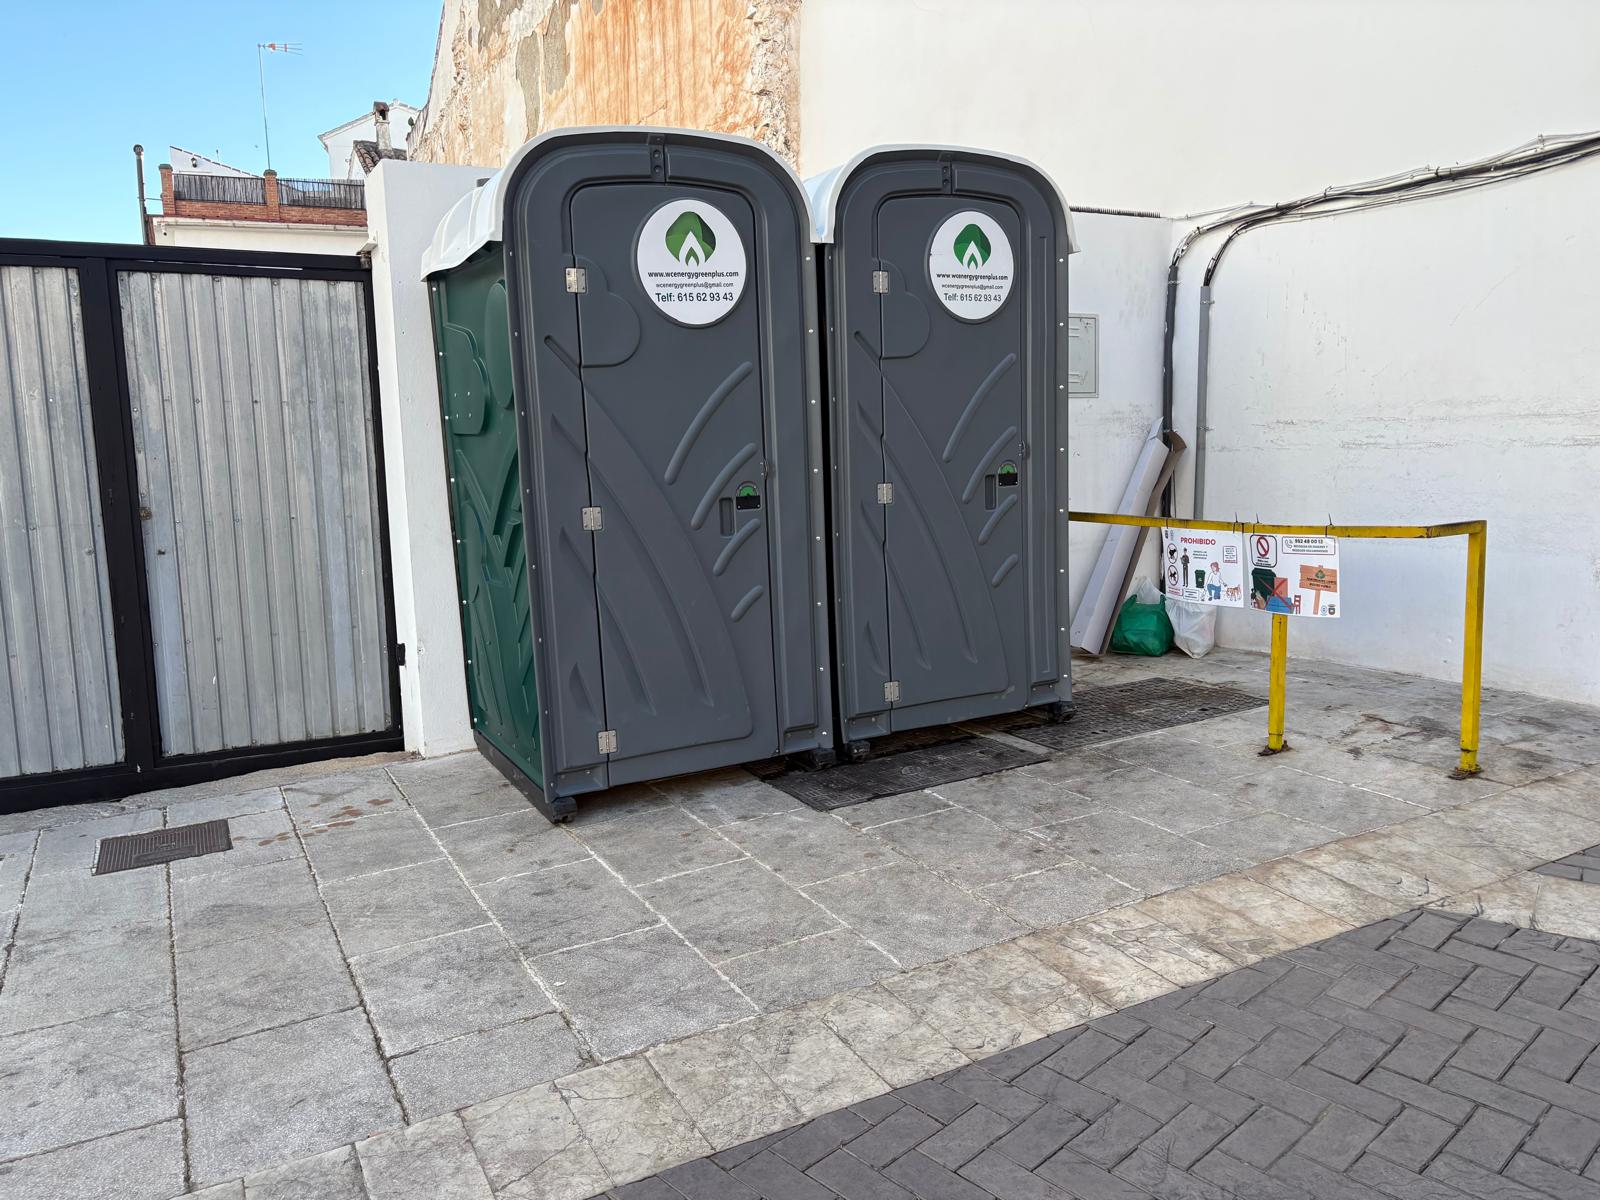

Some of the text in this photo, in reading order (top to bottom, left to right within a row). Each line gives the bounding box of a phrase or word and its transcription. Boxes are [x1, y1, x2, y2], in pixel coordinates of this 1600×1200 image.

[648, 270, 739, 280] www.wcenergygreenplus.com
[936, 272, 1008, 282] www.wcenergygreenplus.com
[655, 292, 734, 302] Telf: 615 62 93 43
[944, 292, 1002, 302] Telf: 615 62 93 43
[1180, 537, 1216, 546] PROHIBIDO
